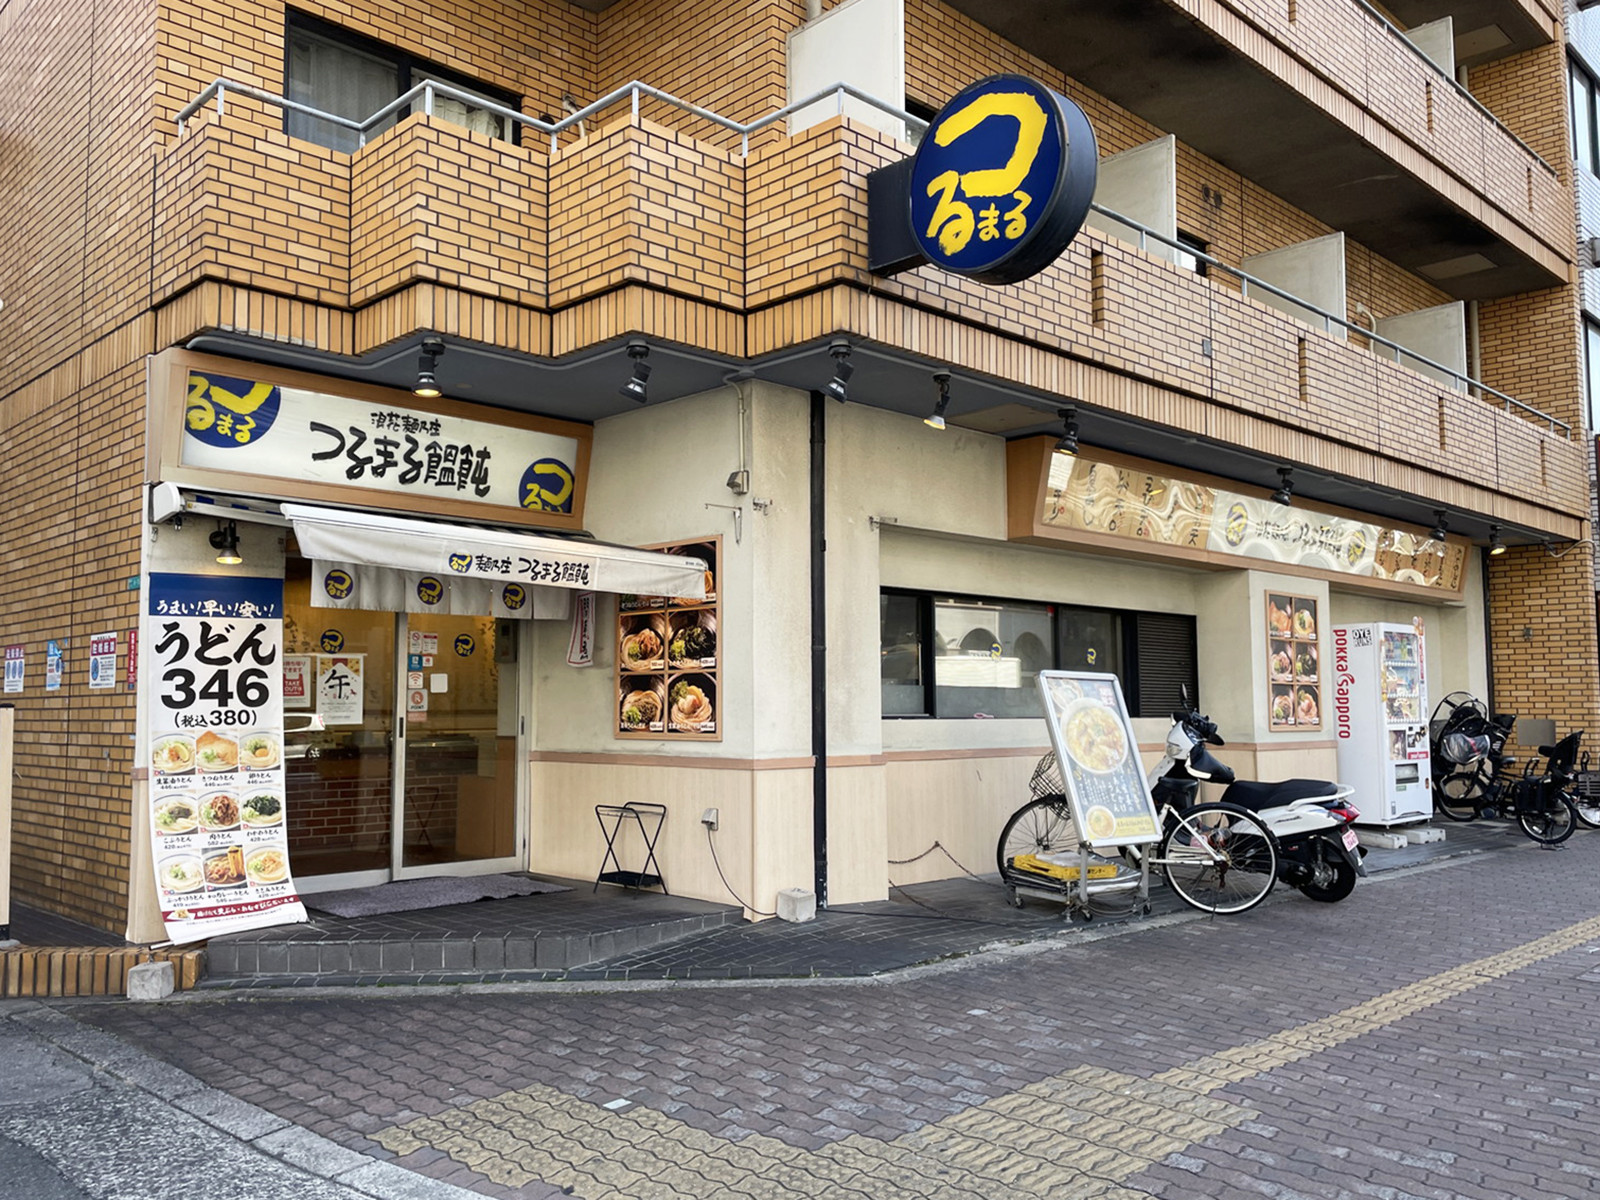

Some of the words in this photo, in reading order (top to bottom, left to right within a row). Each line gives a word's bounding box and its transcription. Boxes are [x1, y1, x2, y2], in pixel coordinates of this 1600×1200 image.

[923, 92, 1048, 256] つるまる
[309, 421, 492, 498] つるまる饂飩
[154, 621, 276, 667] うどん
[161, 668, 269, 709] 346
[174, 709, 257, 728] (税込380)
